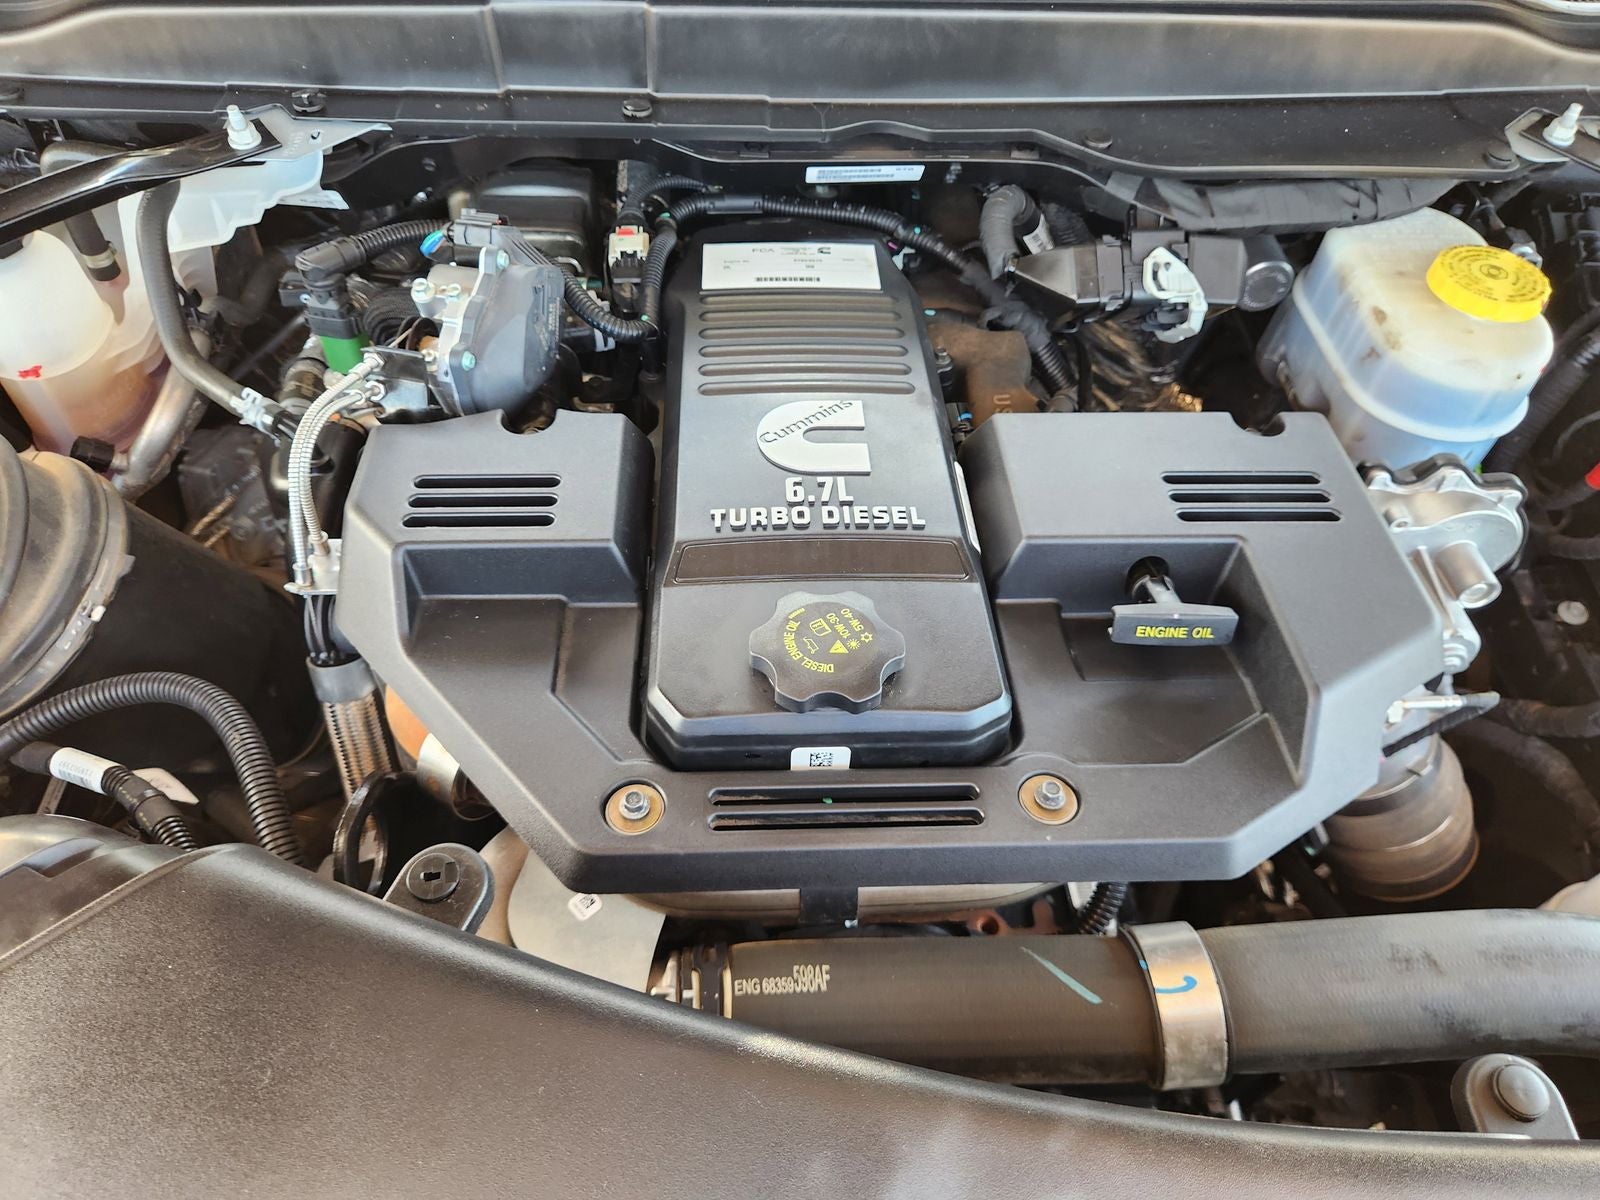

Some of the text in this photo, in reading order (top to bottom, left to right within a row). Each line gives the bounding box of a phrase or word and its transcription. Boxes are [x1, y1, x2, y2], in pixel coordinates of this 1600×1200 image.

[759, 400, 853, 443] Cummins
[785, 476, 854, 505] 6.7L
[710, 505, 926, 532] TURBO DIESEL
[786, 620, 801, 631] OIL
[826, 613, 850, 639] 10W-30
[841, 608, 864, 632] 5W-40
[1135, 626, 1215, 639] ENGINE OIL
[784, 632, 803, 661] ENGINE
[801, 660, 834, 673] DIESEL
[734, 978, 761, 996] ENG
